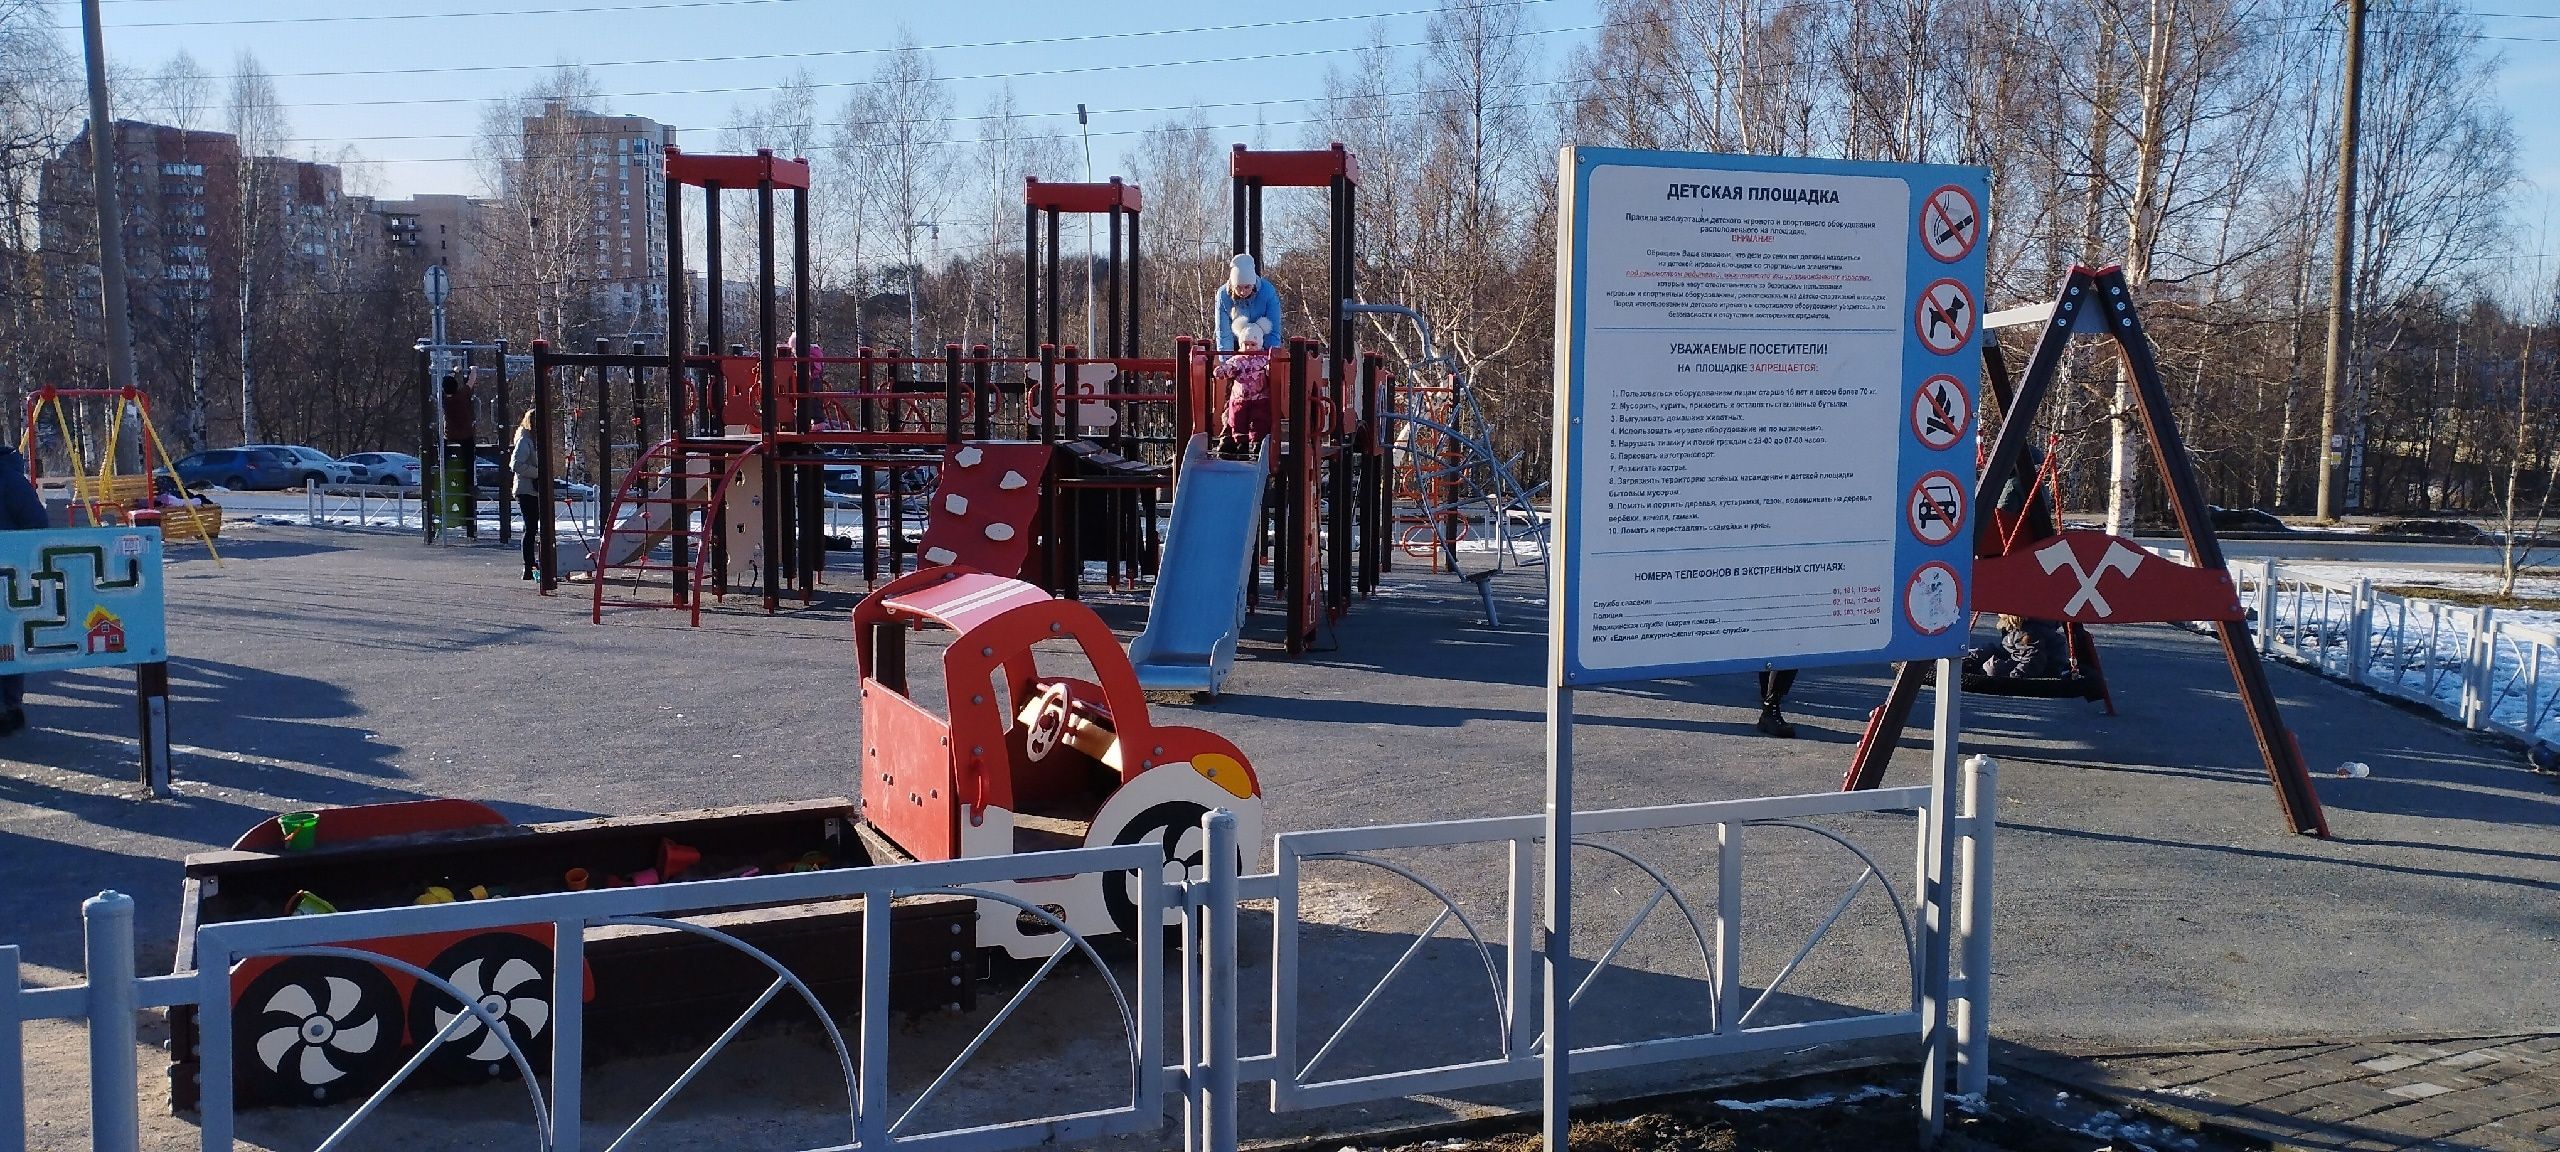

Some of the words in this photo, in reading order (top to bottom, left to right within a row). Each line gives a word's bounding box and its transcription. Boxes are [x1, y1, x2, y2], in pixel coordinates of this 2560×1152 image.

[1667, 184, 1743, 201] ДЕТСКАЯ
[1748, 187, 1840, 205] ПЛОЩАДКА
[1710, 217, 1742, 225] детского
[1782, 219, 1826, 229] спортивного
[1827, 219, 1876, 230] оборудования
[1669, 343, 1747, 355] УВАЖАЕМЫЕ
[1749, 343, 1828, 355] ПОСЕТИТЕЛИ!
[1677, 363, 1691, 373] НА
[1695, 363, 1748, 374] ПЛОЩАДКЕ
[1749, 363, 1819, 374] ЗАПРЕЩАЕТСЯ:
[1838, 388, 1859, 396] более
[1860, 387, 1868, 396] 70
[1611, 402, 1618, 410] 2.
[1660, 402, 1688, 410] курить,
[1818, 400, 1848, 409] бутылки
[1618, 427, 1673, 436] Использовать
[1618, 440, 1656, 449] Нарушать
[1692, 438, 1715, 446] покой
[1609, 477, 1616, 485] 8.
[1790, 471, 1819, 480] детской
[1653, 502, 1684, 510] портить
[1608, 527, 1619, 535] 10.
[1620, 526, 1649, 535] Ломать
[1656, 525, 1708, 534] переставлять
[1634, 571, 1673, 581] НОМЕРА
[1674, 568, 1732, 580] ТЕЛЕФОНОВ
[1733, 567, 1740, 577] В
[1742, 564, 1802, 576] ЭКСТРЕННЫХ
[1803, 562, 1846, 573] СЛУЧАЯХ:
[1593, 599, 1620, 609] Служба
[1593, 612, 1623, 620] Полиция
[1592, 635, 1607, 643] МКУ
